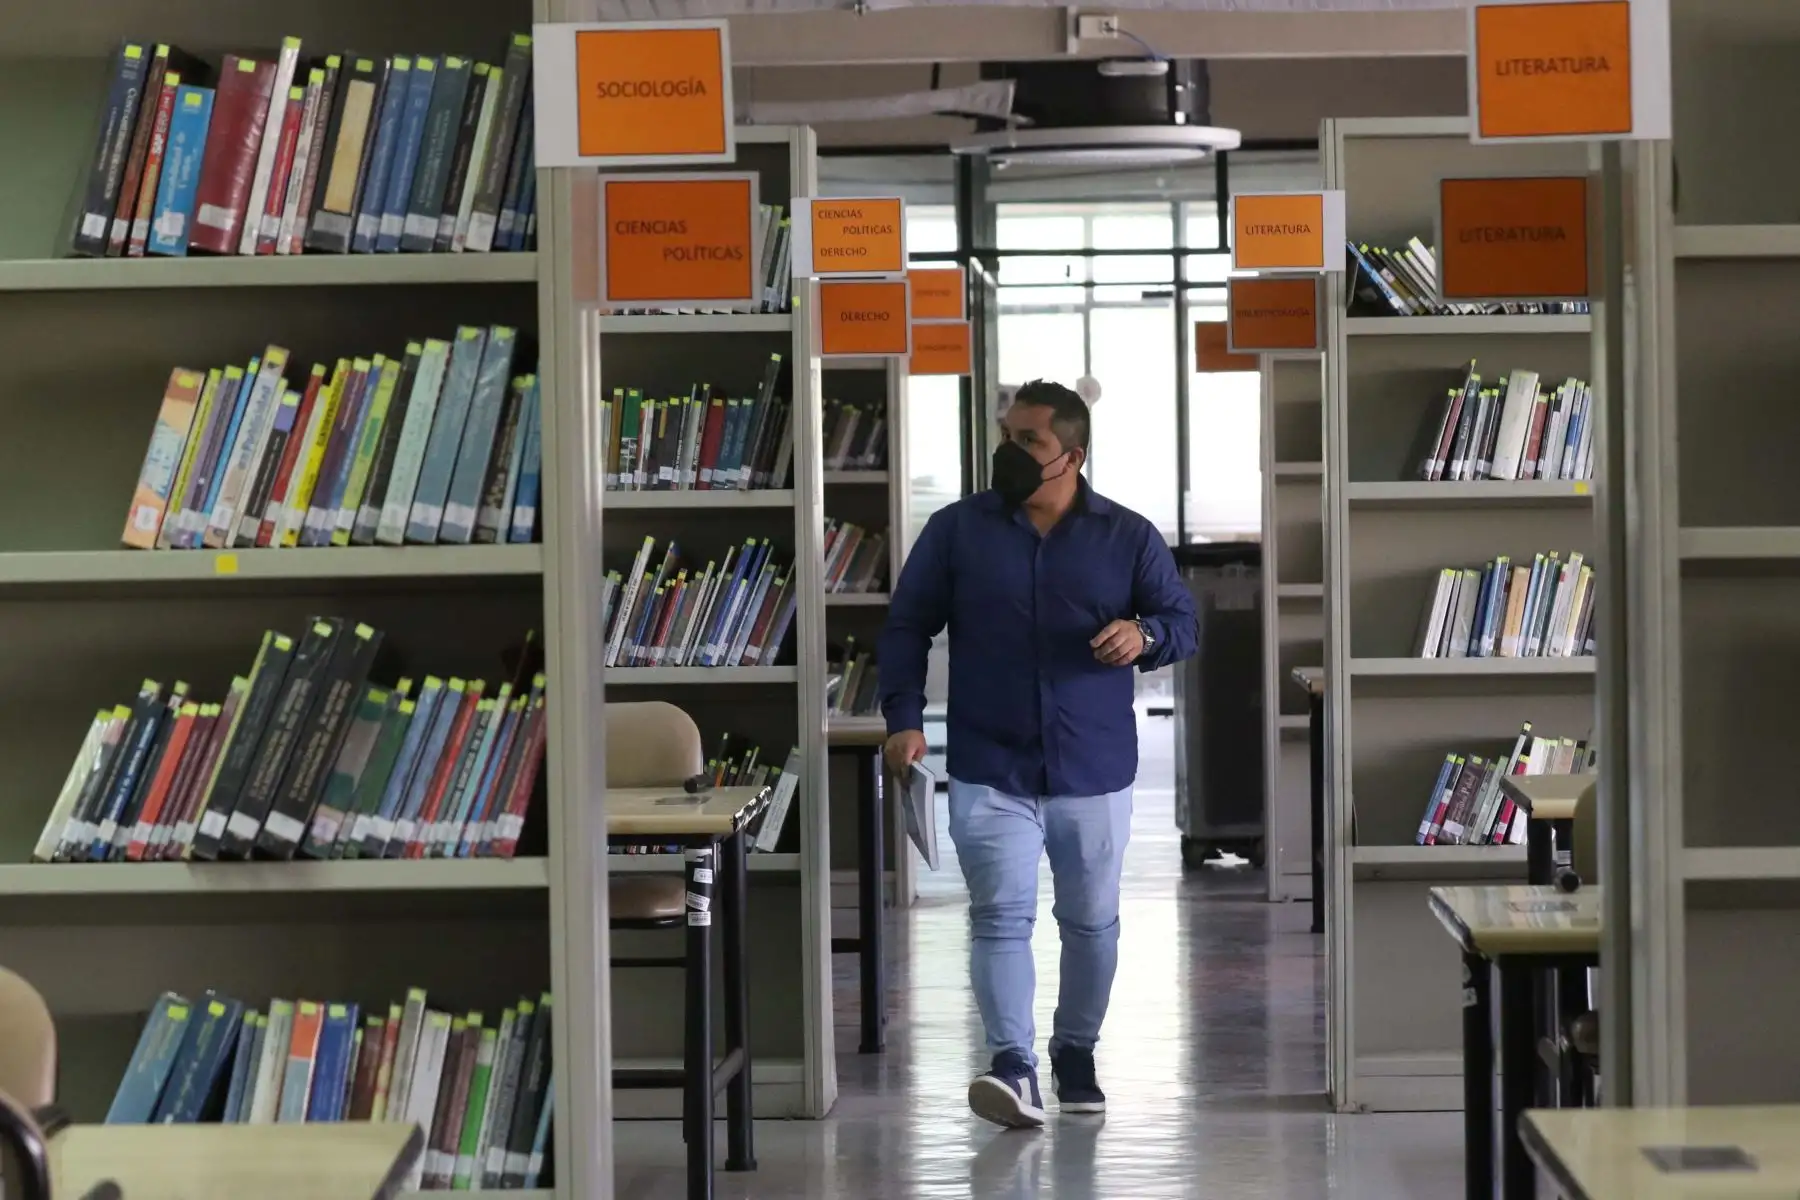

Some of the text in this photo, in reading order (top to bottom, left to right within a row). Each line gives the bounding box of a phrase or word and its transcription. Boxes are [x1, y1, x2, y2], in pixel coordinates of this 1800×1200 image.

[1496, 55, 1610, 77] LITERATURA
[597, 76, 707, 99] SOCIOLOGÍA
[817, 209, 863, 219] CIENCIAS
[615, 220, 688, 235] CIENCIAS
[842, 223, 893, 235] POLÍTICAS
[1245, 224, 1311, 236] LITERATURA
[1459, 226, 1566, 244] LITERATURA
[663, 244, 744, 262] POLÍTICAS
[820, 246, 868, 258] DERECHO
[840, 311, 890, 322] DERECHO
